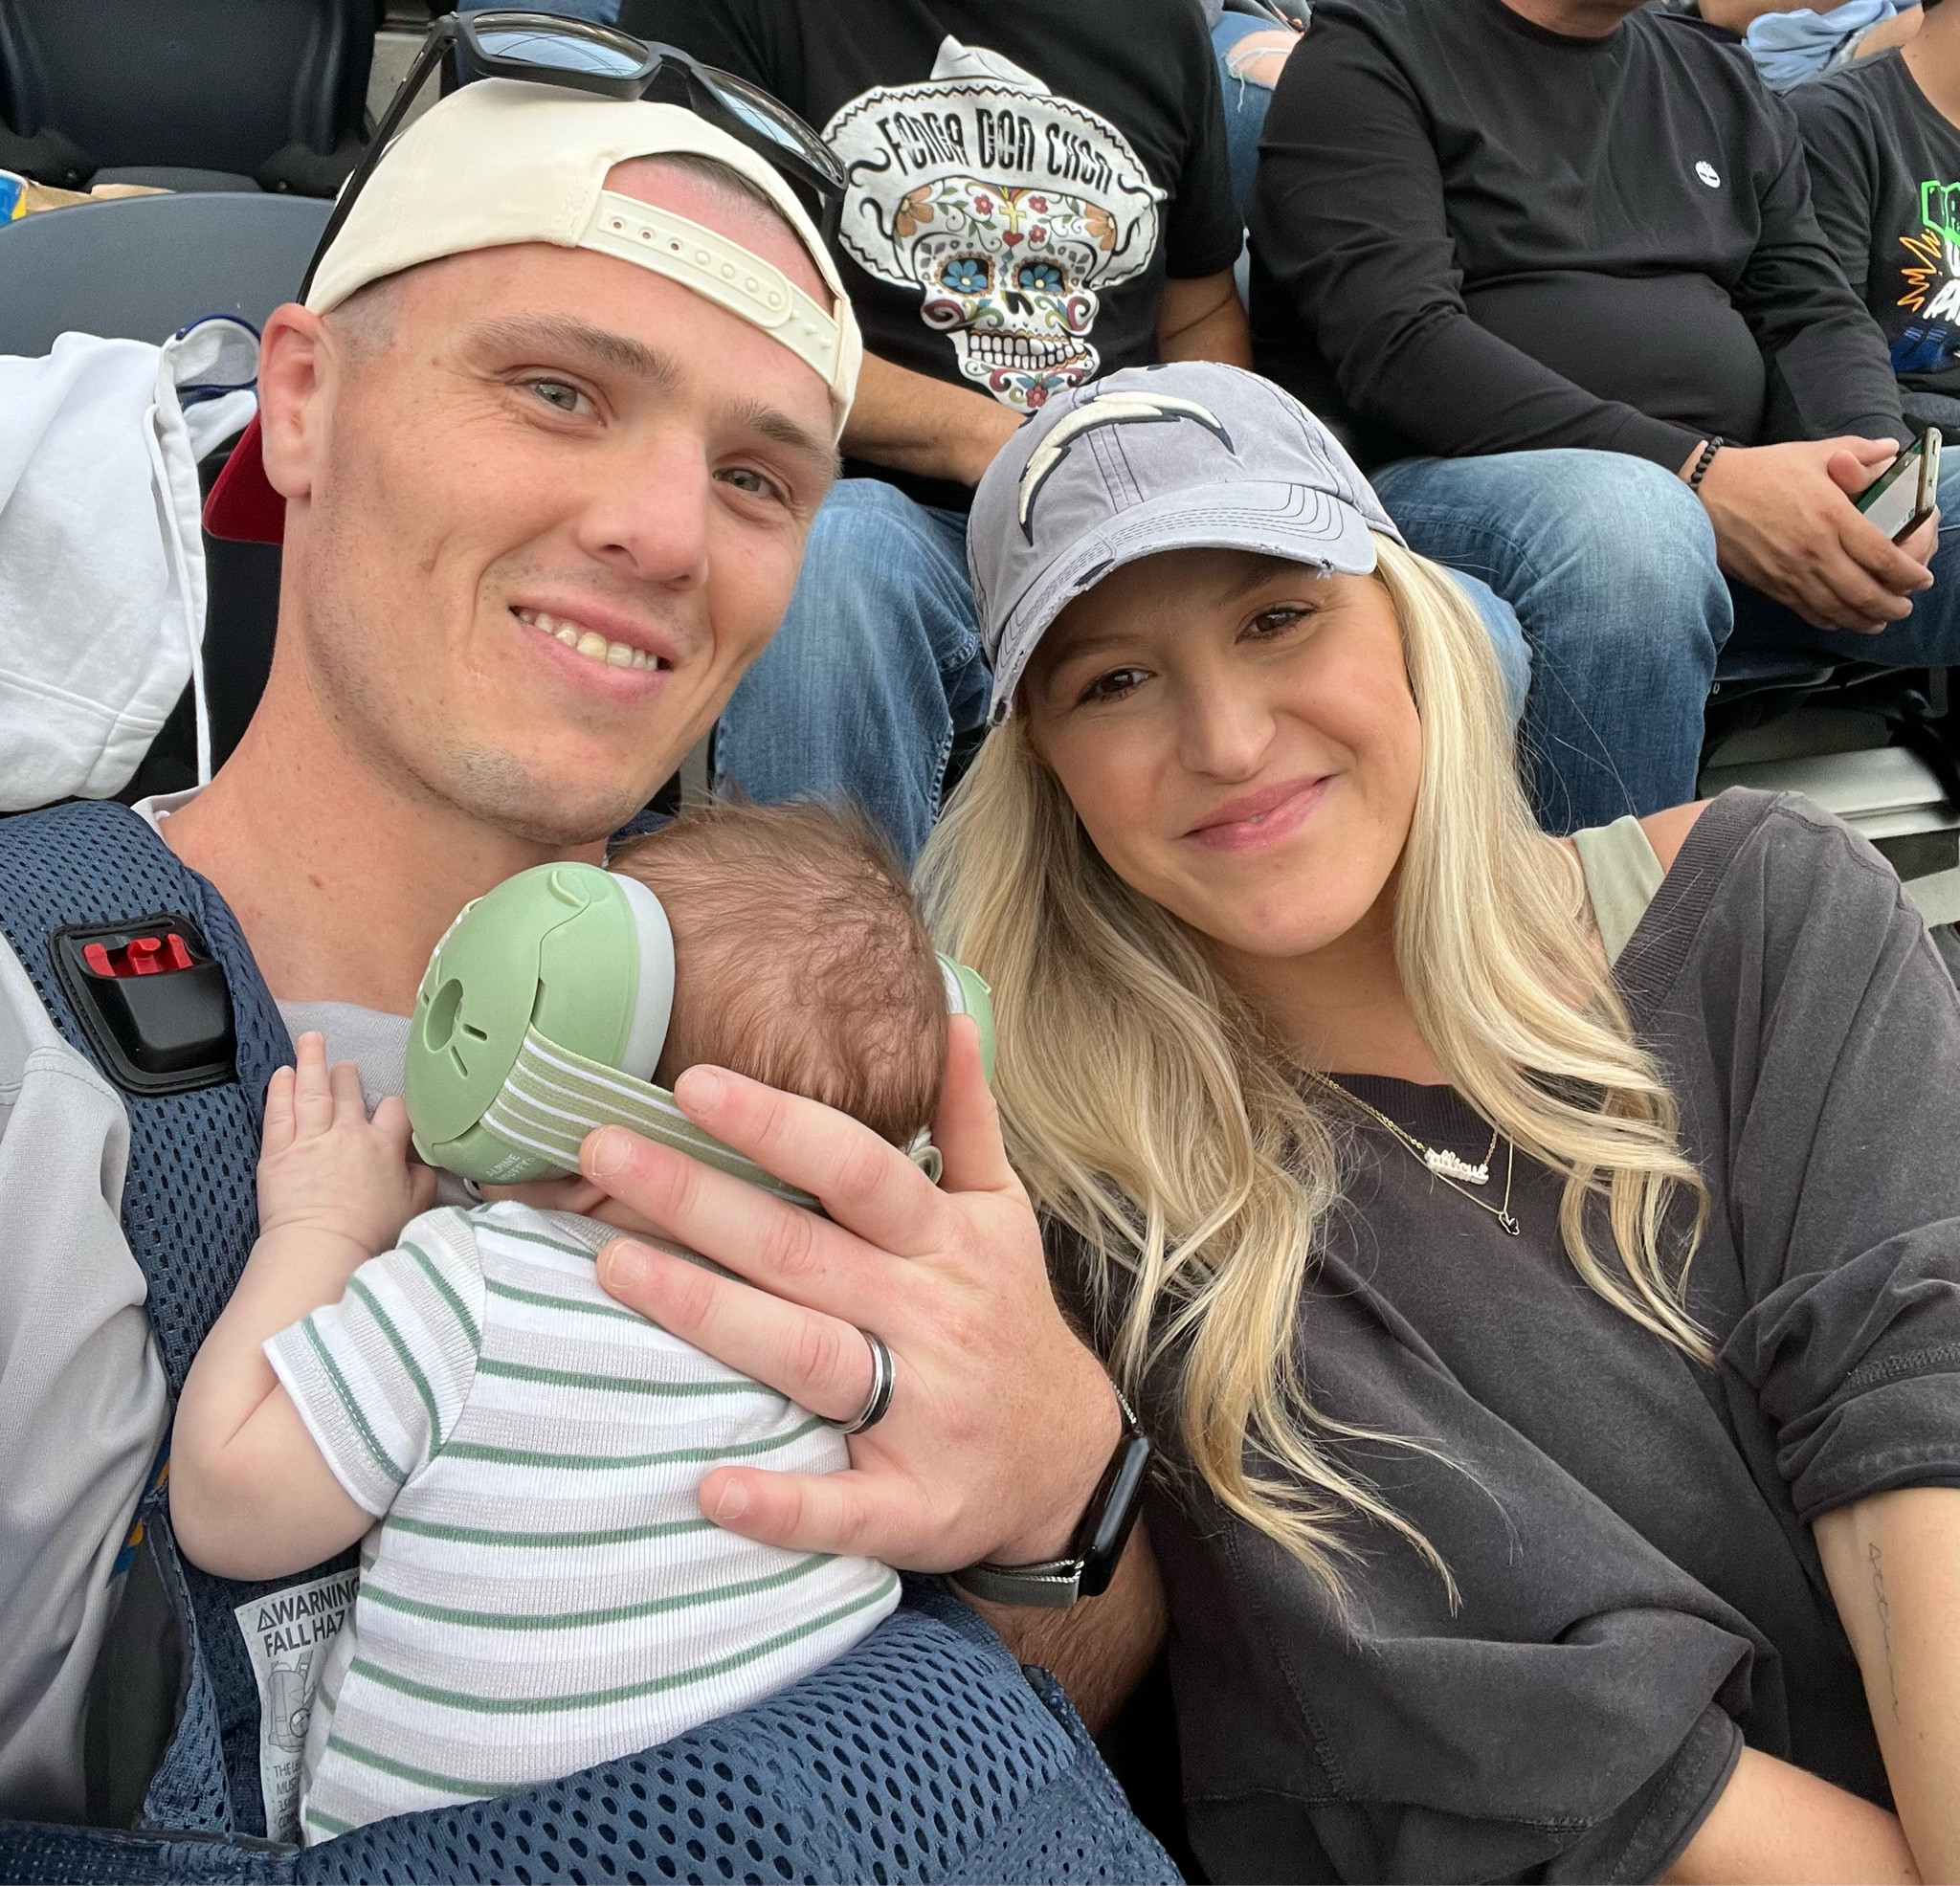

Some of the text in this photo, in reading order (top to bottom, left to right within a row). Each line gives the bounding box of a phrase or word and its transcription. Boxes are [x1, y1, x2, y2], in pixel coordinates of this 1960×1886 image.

[975, 108, 1036, 172] DON
[1045, 122, 1113, 194] CHON
[263, 1609, 345, 1658] FALL HAZ
